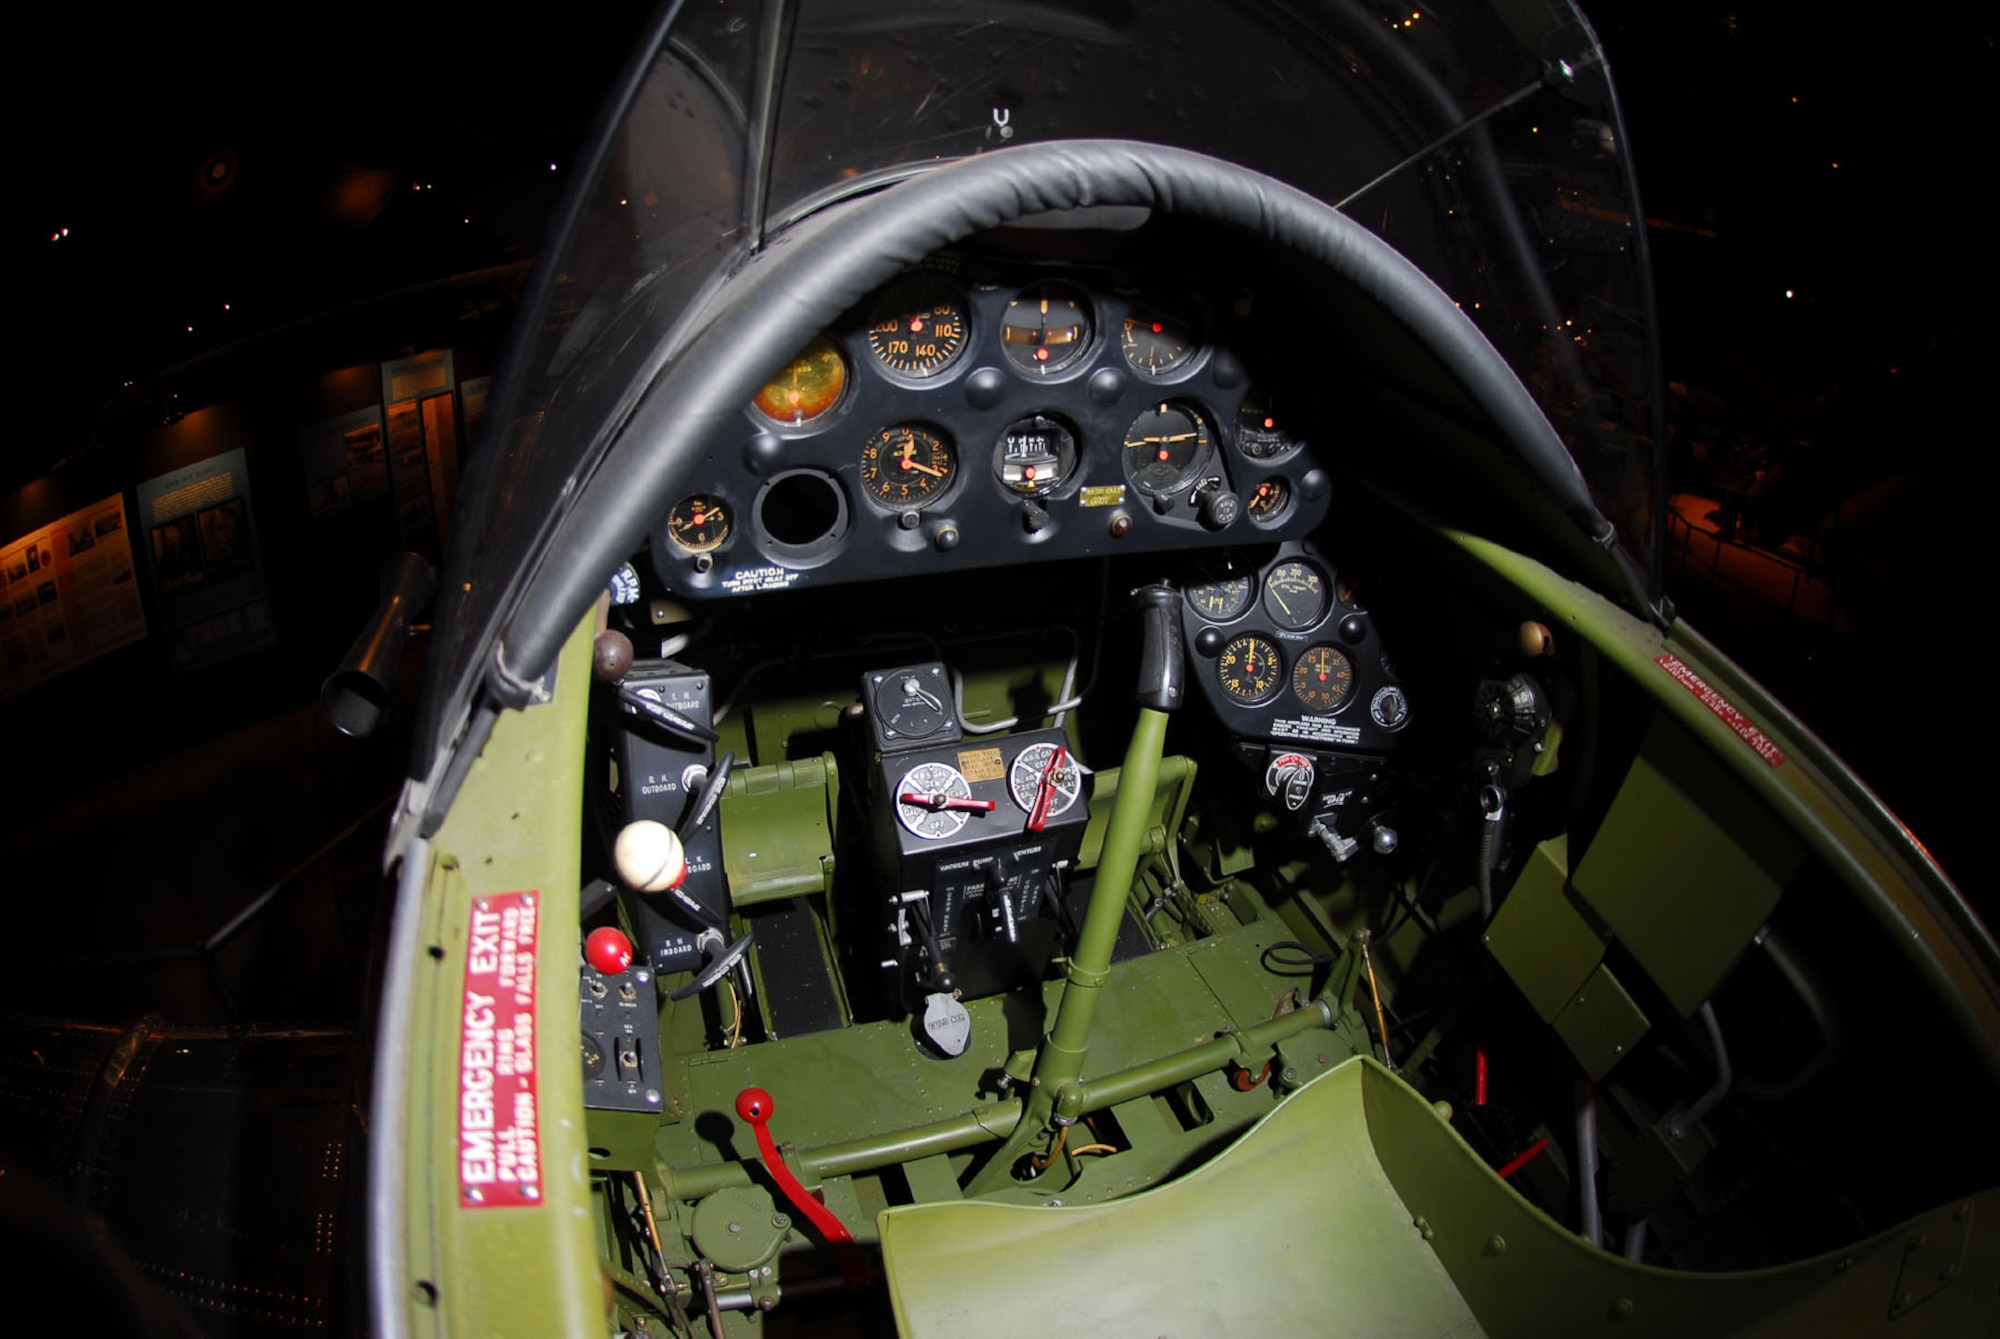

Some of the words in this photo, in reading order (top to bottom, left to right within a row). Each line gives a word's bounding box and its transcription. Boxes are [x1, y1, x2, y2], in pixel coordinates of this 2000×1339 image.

[936, 325, 952, 337] 110
[888, 341, 908, 353] 170
[916, 344, 936, 356] 140
[882, 433, 889, 443] 9
[933, 441, 940, 450] 2
[870, 449, 877, 458] 8
[870, 468, 877, 479] 7
[882, 482, 890, 492] 6
[920, 478, 926, 487] 4
[901, 485, 908, 495] 5
[736, 567, 784, 580] CAUTION
[1226, 655, 1236, 664] 20
[1267, 657, 1273, 666] 5
[1232, 679, 1240, 688] 15
[1256, 680, 1265, 688] 10
[1672, 660, 1744, 720] EMERGENCY
[1748, 726, 1779, 753] EXIT
[1301, 715, 1336, 725] WARNING
[642, 783, 677, 794] OUTBOARD
[687, 863, 711, 873] BOARD
[939, 861, 969, 871] VACUUM
[973, 857, 993, 866] PUMP
[517, 906, 536, 945] FREE
[470, 910, 500, 974] EXIT
[499, 907, 519, 987] FORWARD
[660, 944, 692, 956] INBOARD
[515, 951, 534, 1005] FALLS
[514, 1012, 533, 1074] GLASS
[462, 991, 496, 1184] EMERGENCY
[514, 1092, 538, 1182] CAUTION
[497, 1125, 517, 1182] PULL
